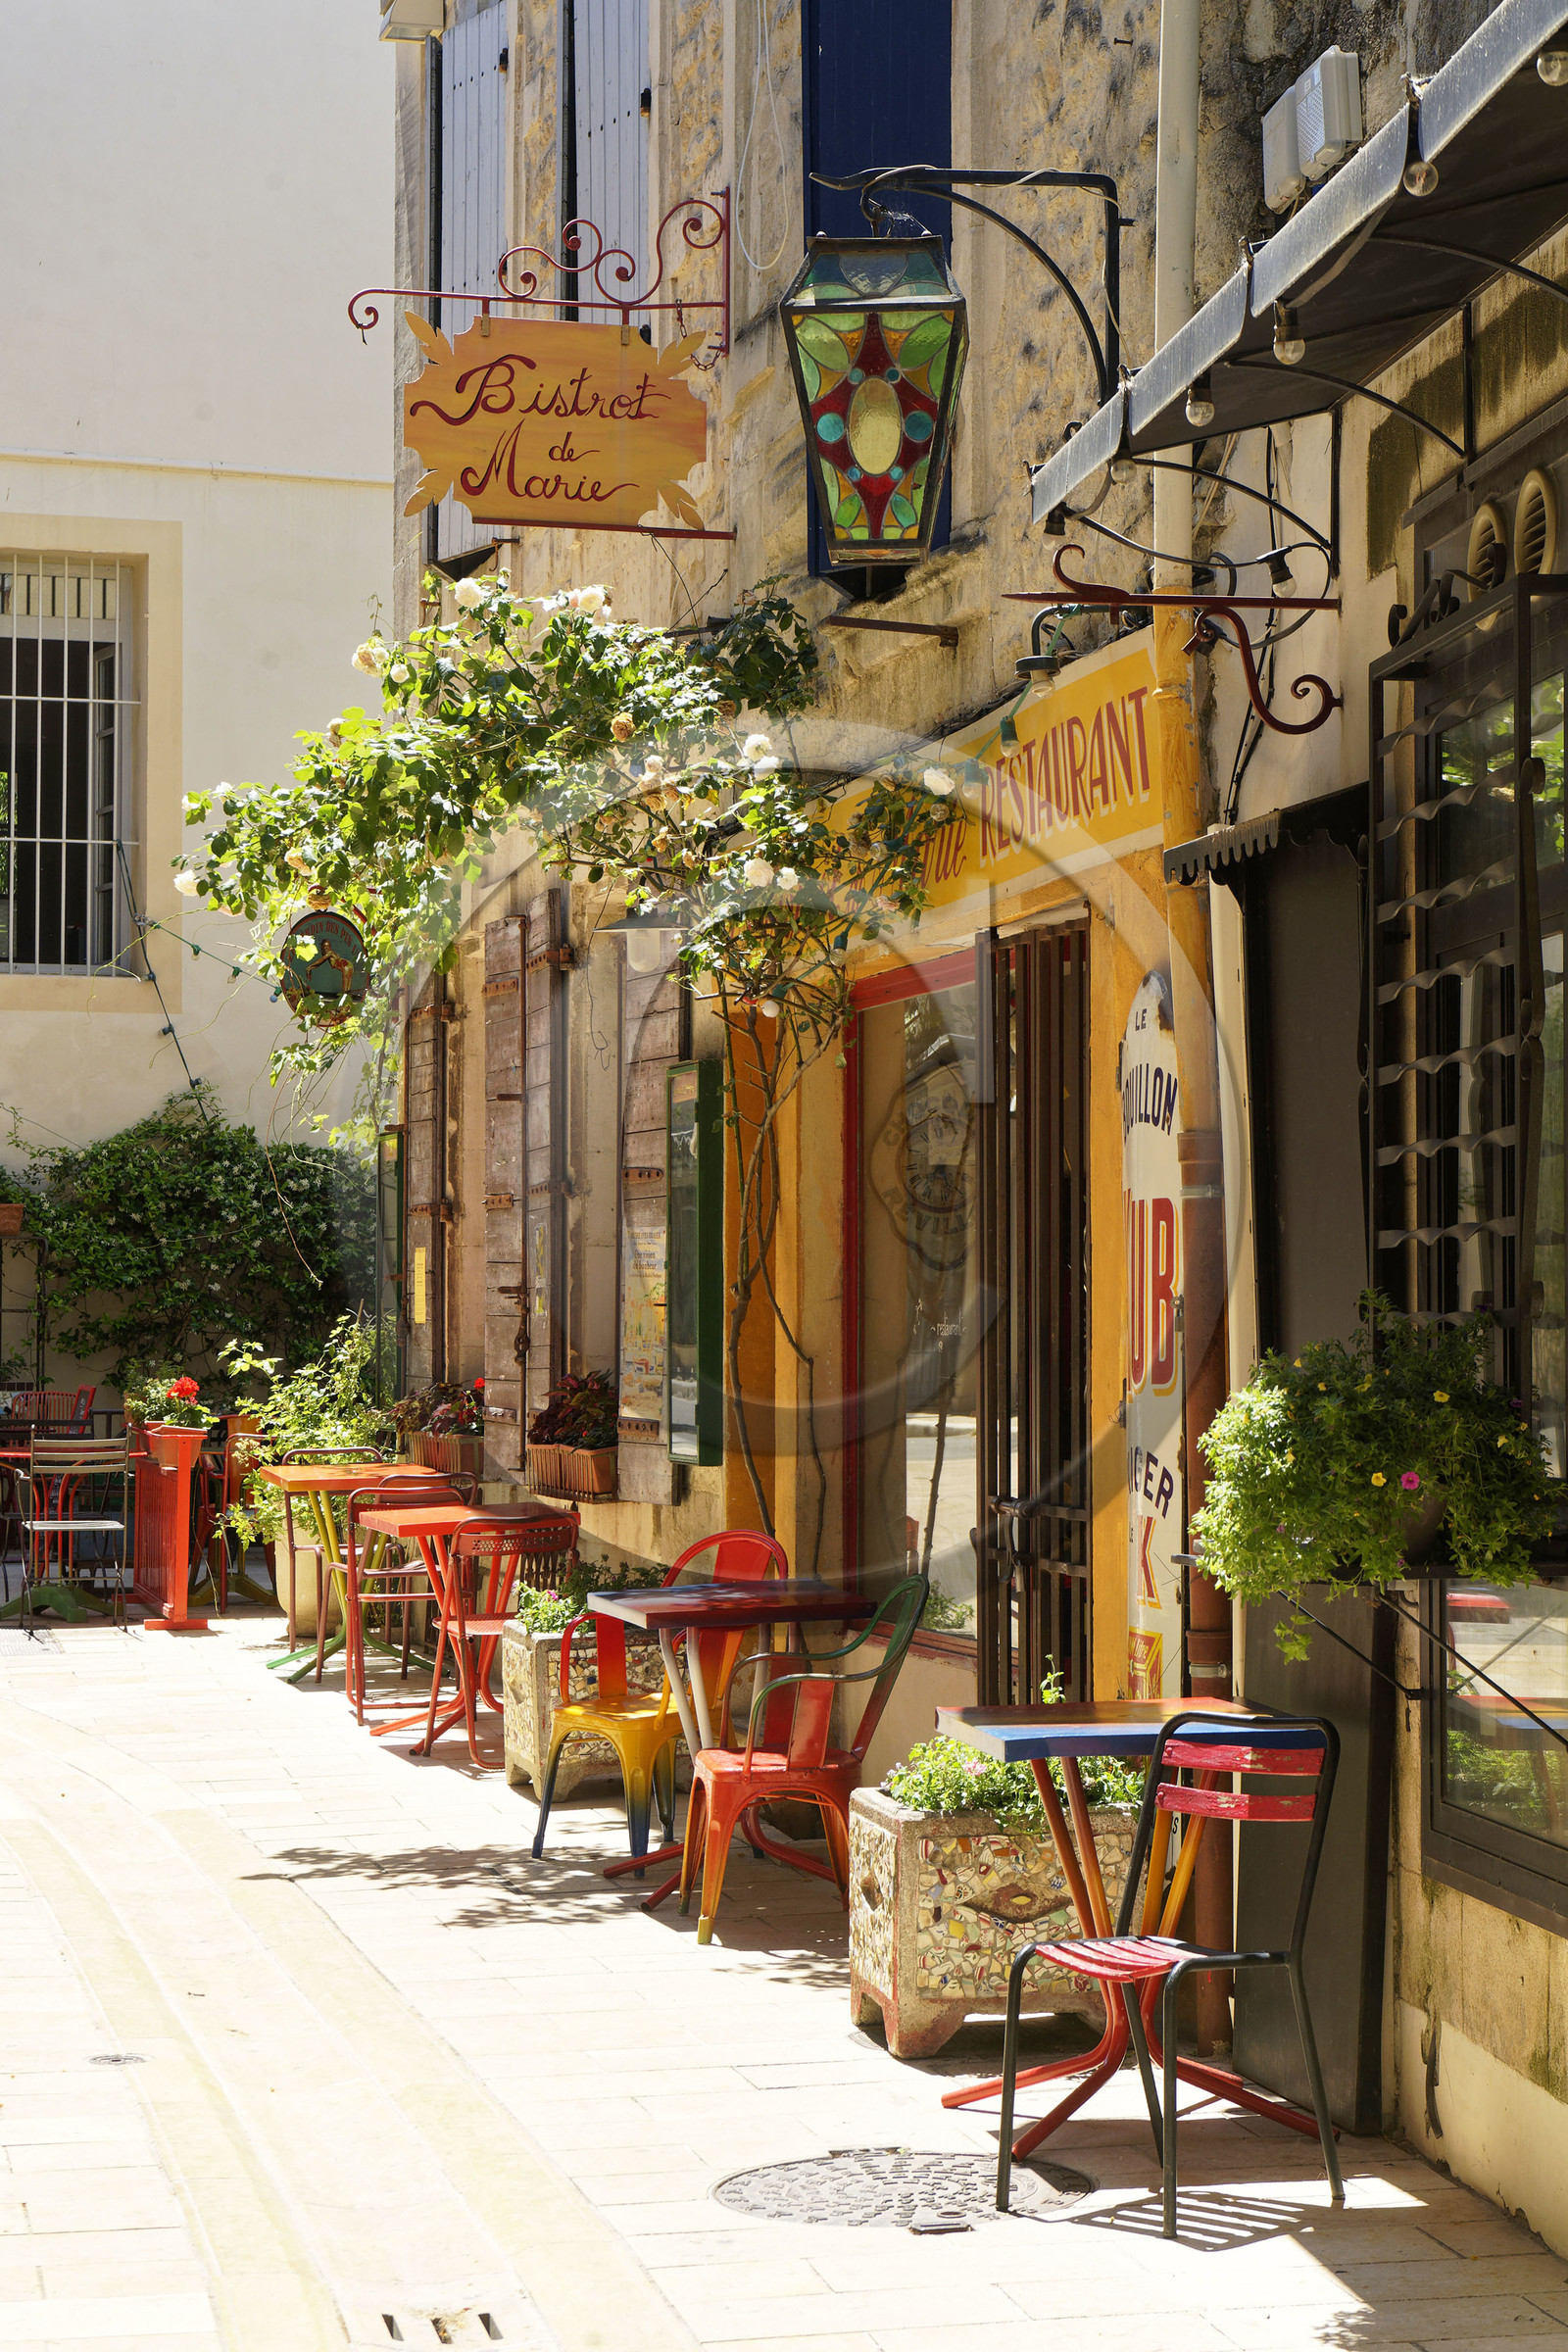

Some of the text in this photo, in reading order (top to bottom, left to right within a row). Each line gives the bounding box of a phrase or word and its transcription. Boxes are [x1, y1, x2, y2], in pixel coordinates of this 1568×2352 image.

[410, 354, 672, 426] Bistrot
[460, 418, 640, 502] Marie
[548, 431, 601, 462] de
[981, 686, 1149, 866] RESTAURANT
[1135, 1007, 1148, 1032] LE
